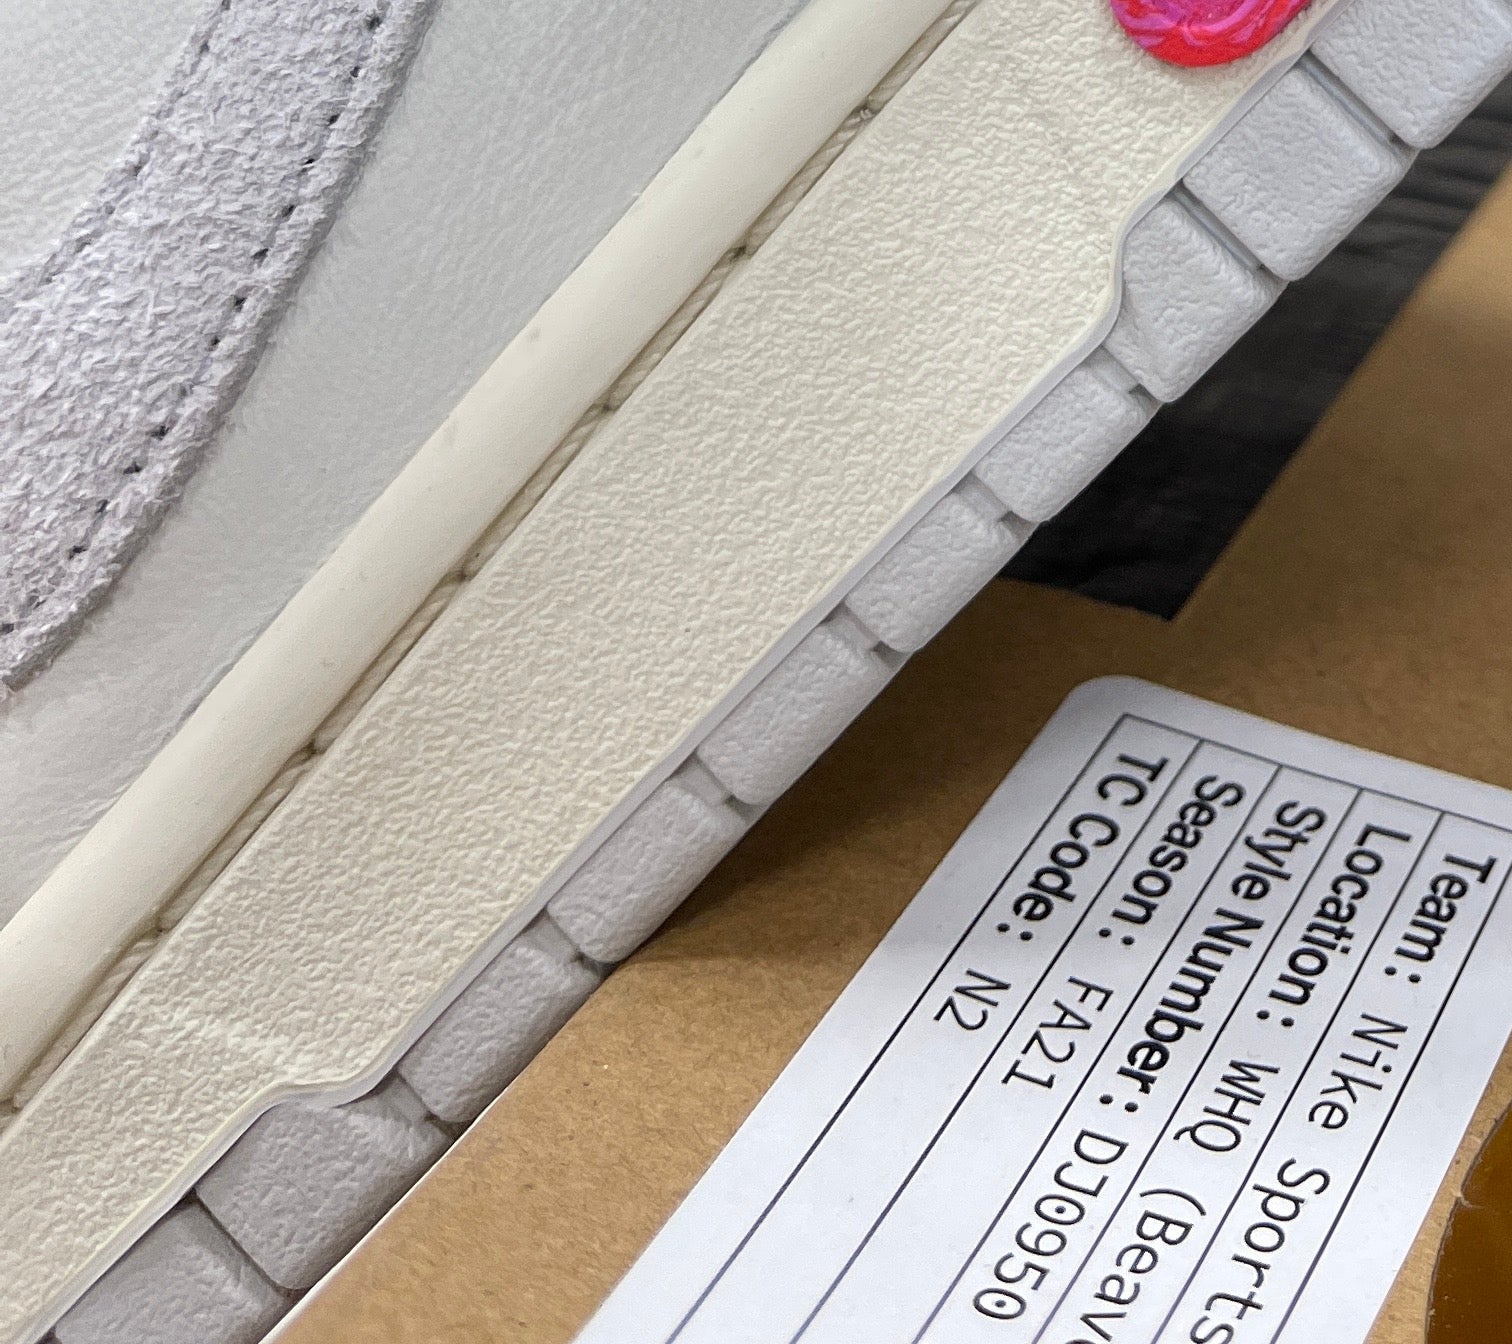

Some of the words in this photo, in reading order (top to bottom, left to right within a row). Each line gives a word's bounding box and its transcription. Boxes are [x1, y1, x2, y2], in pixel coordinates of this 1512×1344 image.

[1098, 752, 1170, 807] TC
[991, 812, 1120, 947] Code:
[1098, 774, 1246, 947] Season:
[1231, 799, 1327, 902] Style
[1256, 822, 1412, 1028] Location:
[1383, 853, 1498, 985] Team:
[932, 969, 1012, 1032] N2
[1000, 975, 1115, 1090] FA21
[1098, 907, 1265, 1114] Number:
[1172, 1058, 1281, 1153] WHQ
[1306, 1012, 1409, 1131] Nike
[972, 1129, 1129, 1321] DJ0950
[1064, 1188, 1207, 1344] (Beav
